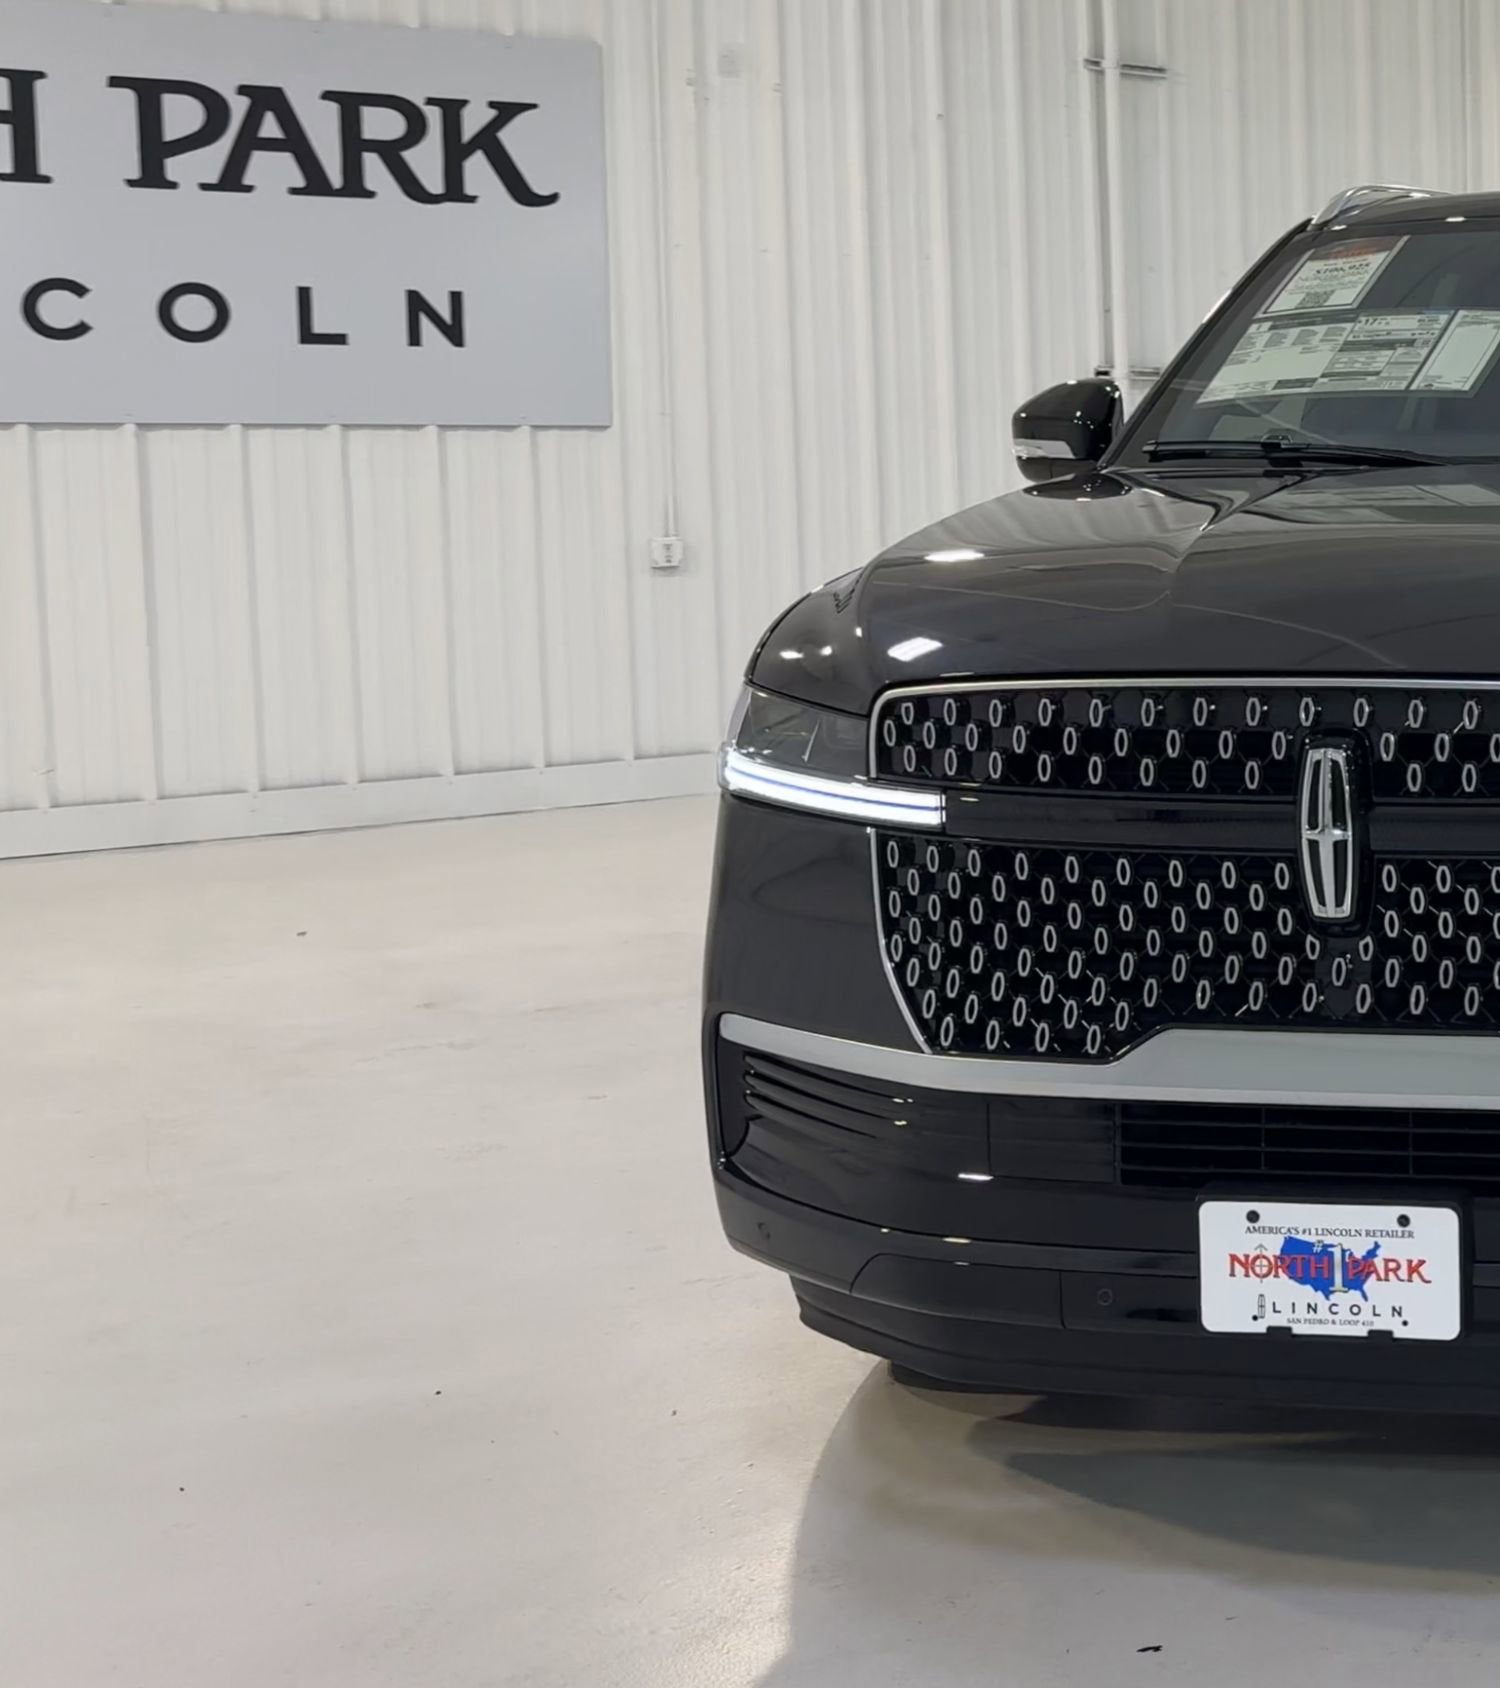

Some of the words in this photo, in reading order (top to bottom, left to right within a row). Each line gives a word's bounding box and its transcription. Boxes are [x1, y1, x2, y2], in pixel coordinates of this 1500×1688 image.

[106, 74, 561, 208] PARK
[1244, 1225, 1299, 1236] AMERICA'S
[1301, 1227, 1313, 1237] #1
[1314, 1227, 1362, 1238] LINCOLN
[1365, 1229, 1415, 1239] RETAILER
[1228, 1253, 1330, 1280] NORTH
[1346, 1253, 1432, 1284] PARK
[1272, 1301, 1403, 1318] LINCOLN
